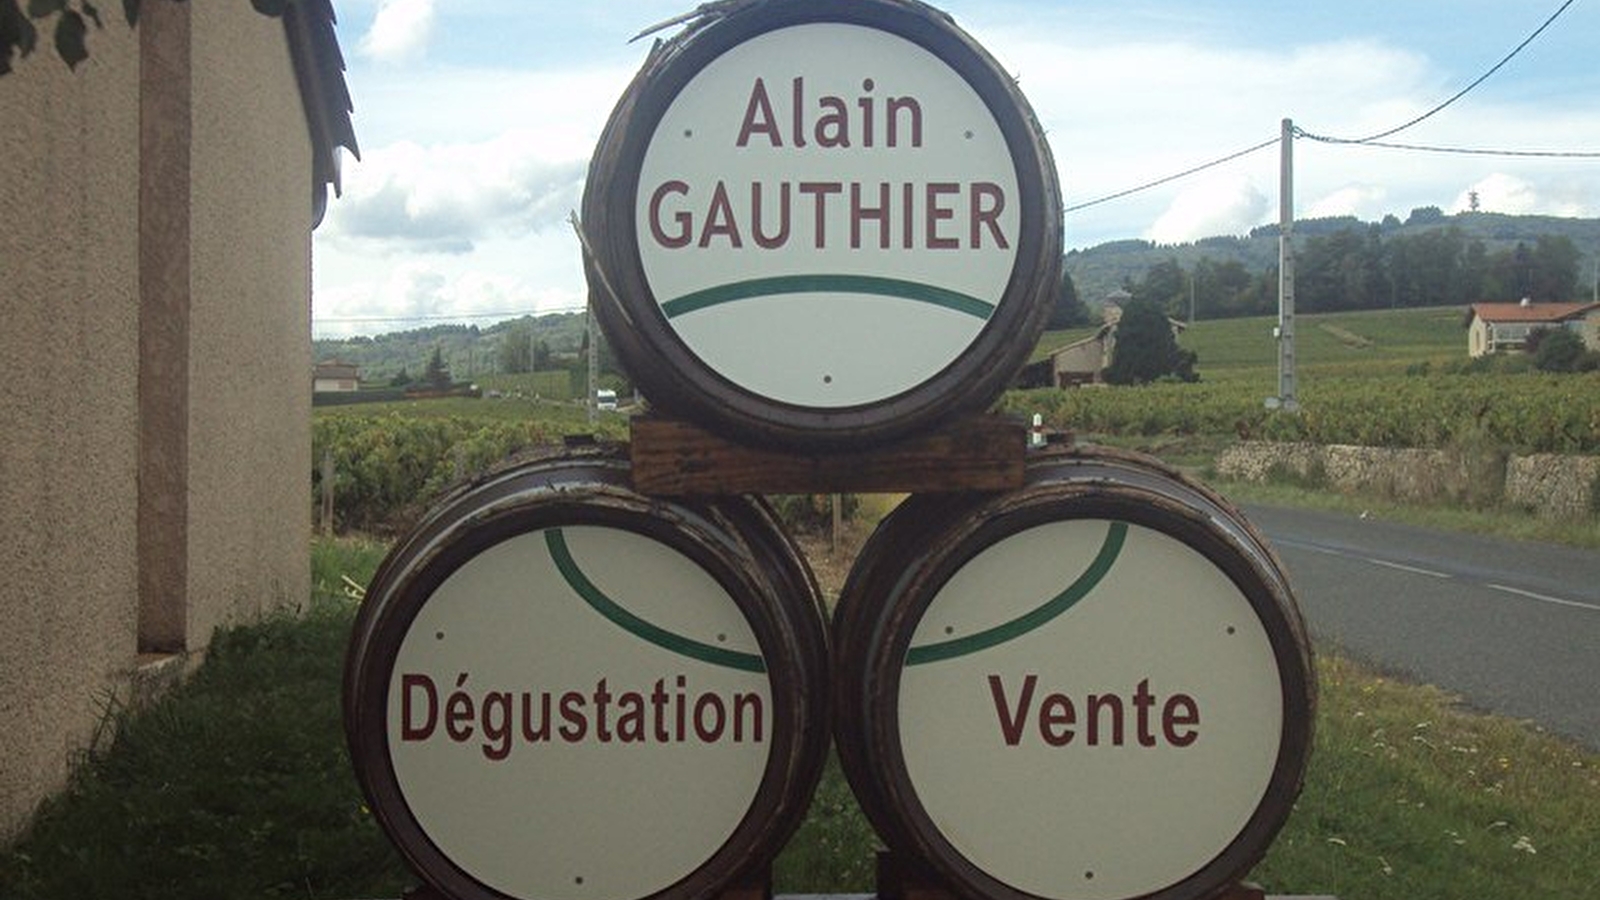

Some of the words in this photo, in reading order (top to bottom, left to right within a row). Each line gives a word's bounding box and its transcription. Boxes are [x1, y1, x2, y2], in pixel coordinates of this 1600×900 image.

[736, 76, 922, 148] Alain
[649, 180, 1009, 249] GAUTHIER
[401, 673, 763, 761] Dégustation
[988, 675, 1200, 748] Vente
